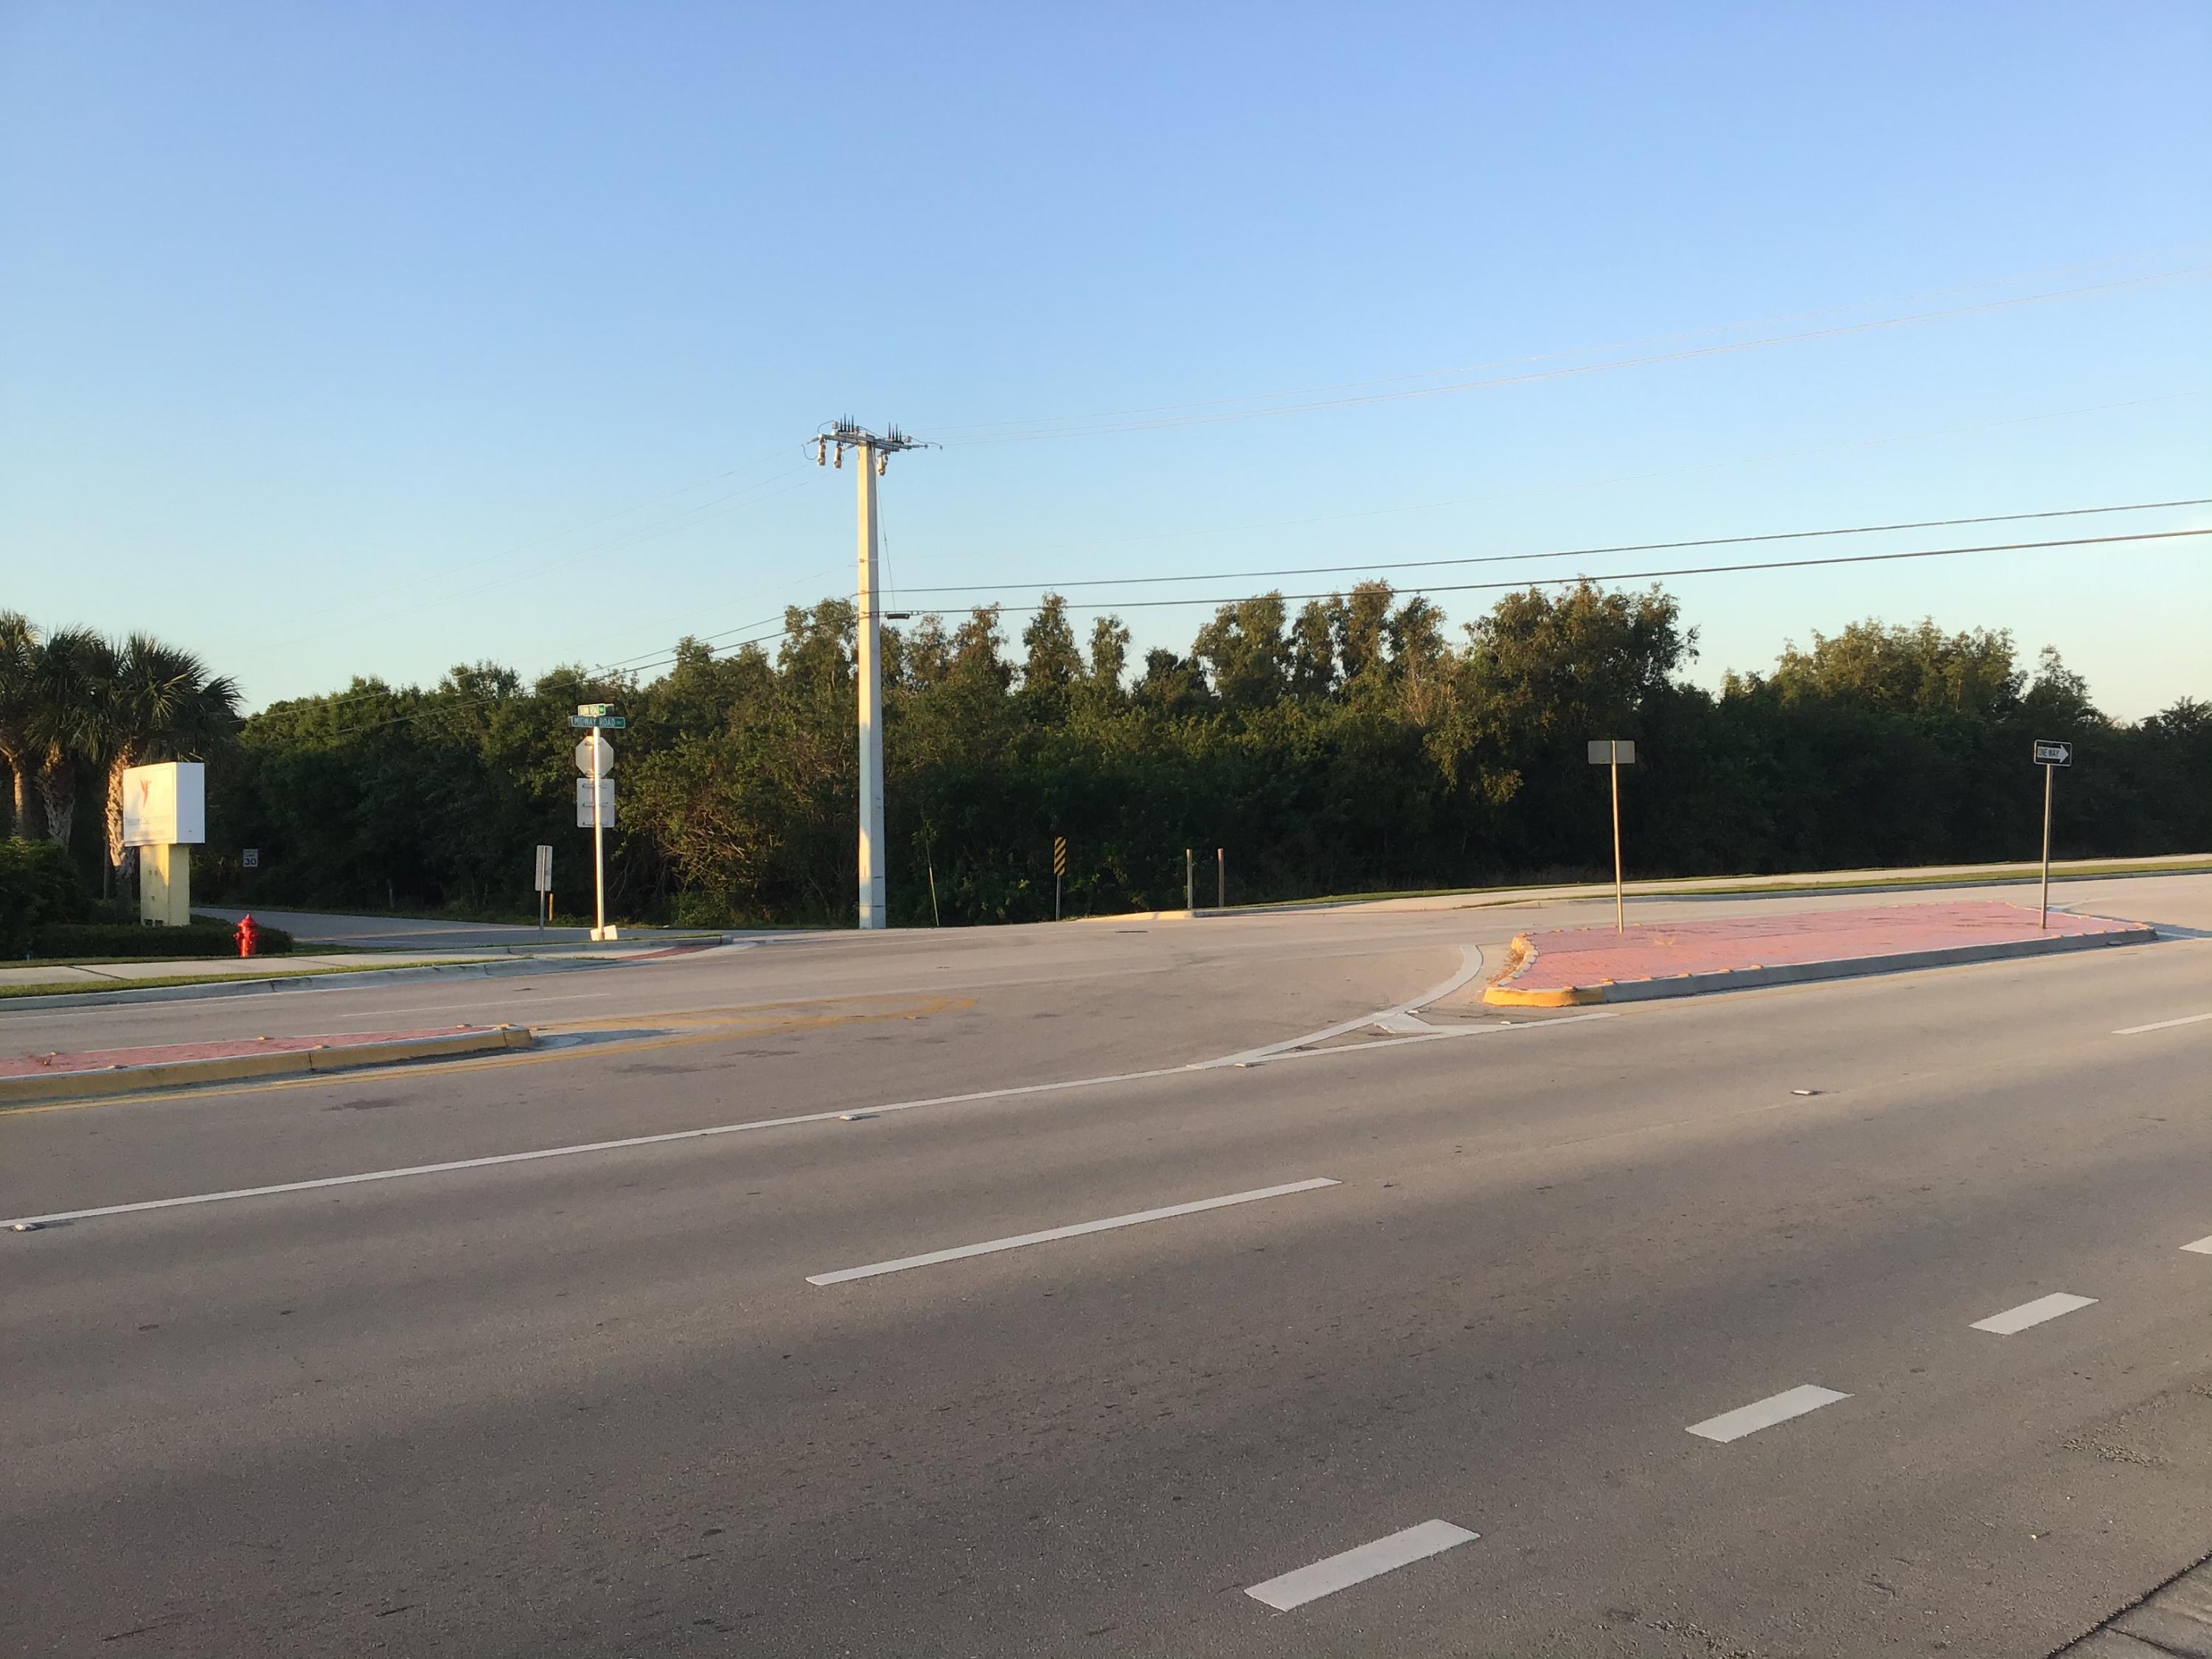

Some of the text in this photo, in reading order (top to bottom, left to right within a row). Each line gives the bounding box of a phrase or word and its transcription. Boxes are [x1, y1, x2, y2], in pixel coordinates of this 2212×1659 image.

[574, 717, 616, 727] MIDWAY ROAD
[2038, 748, 2060, 758] ONE WAY
